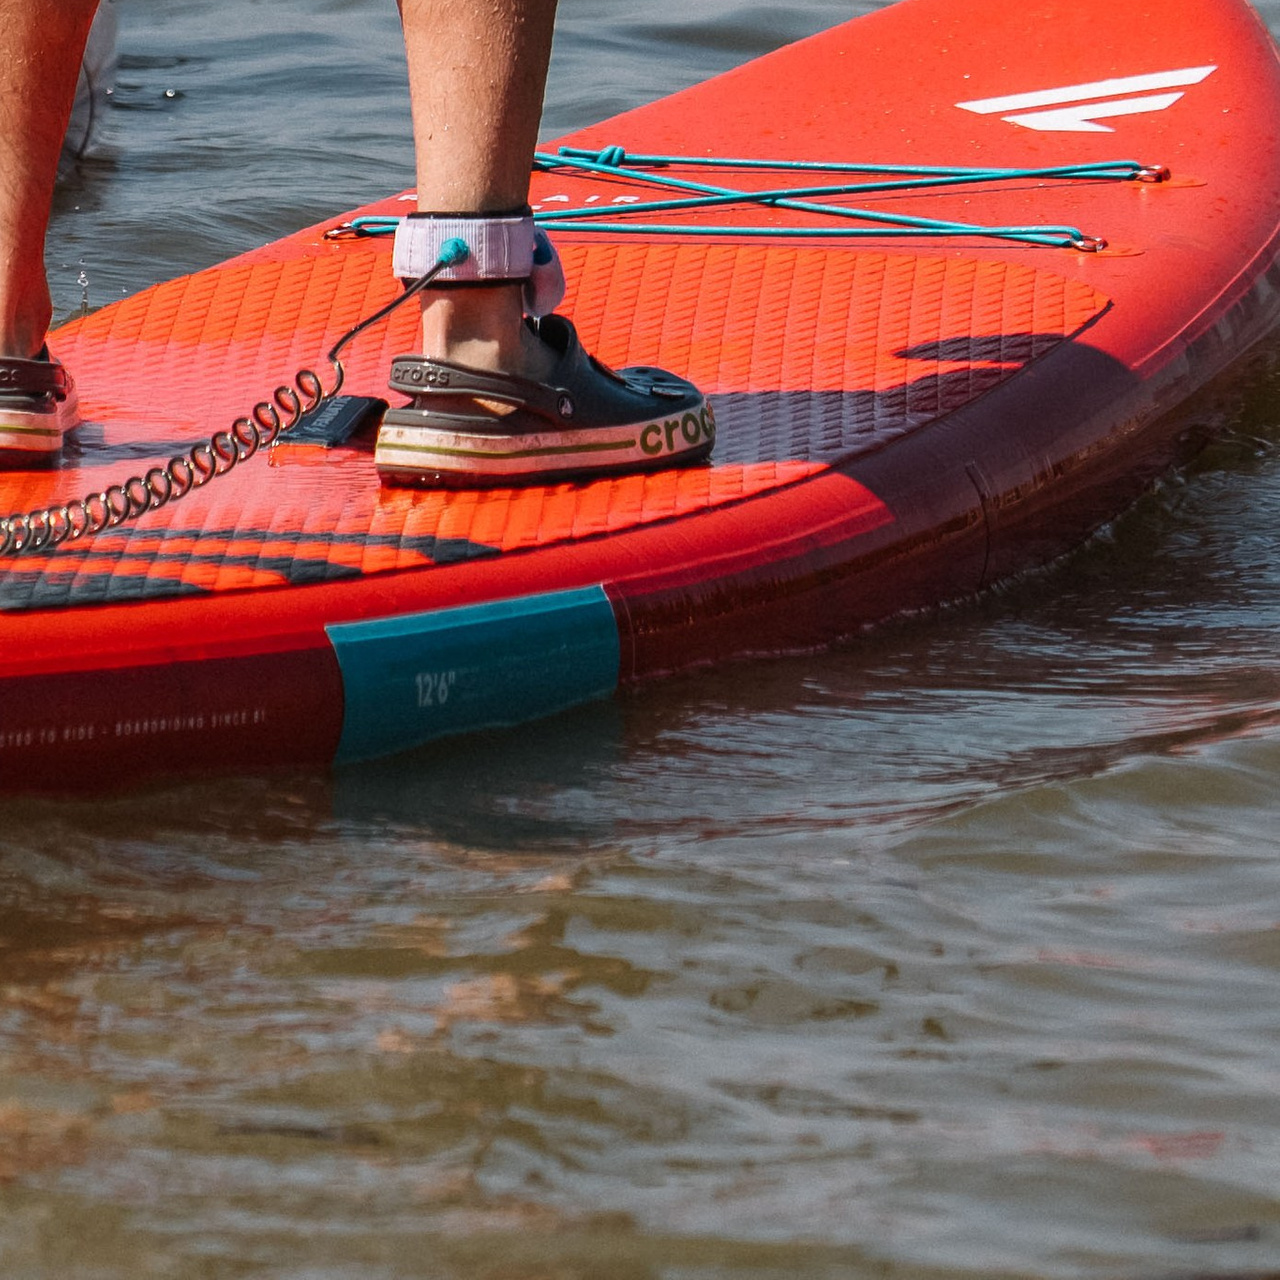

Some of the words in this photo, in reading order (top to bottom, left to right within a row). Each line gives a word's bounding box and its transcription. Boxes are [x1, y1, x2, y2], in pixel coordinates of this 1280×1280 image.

[540, 194, 640, 203] AIR
[393, 367, 450, 386] crocs
[640, 406, 717, 455] croc
[415, 670, 456, 708] 12'6"
